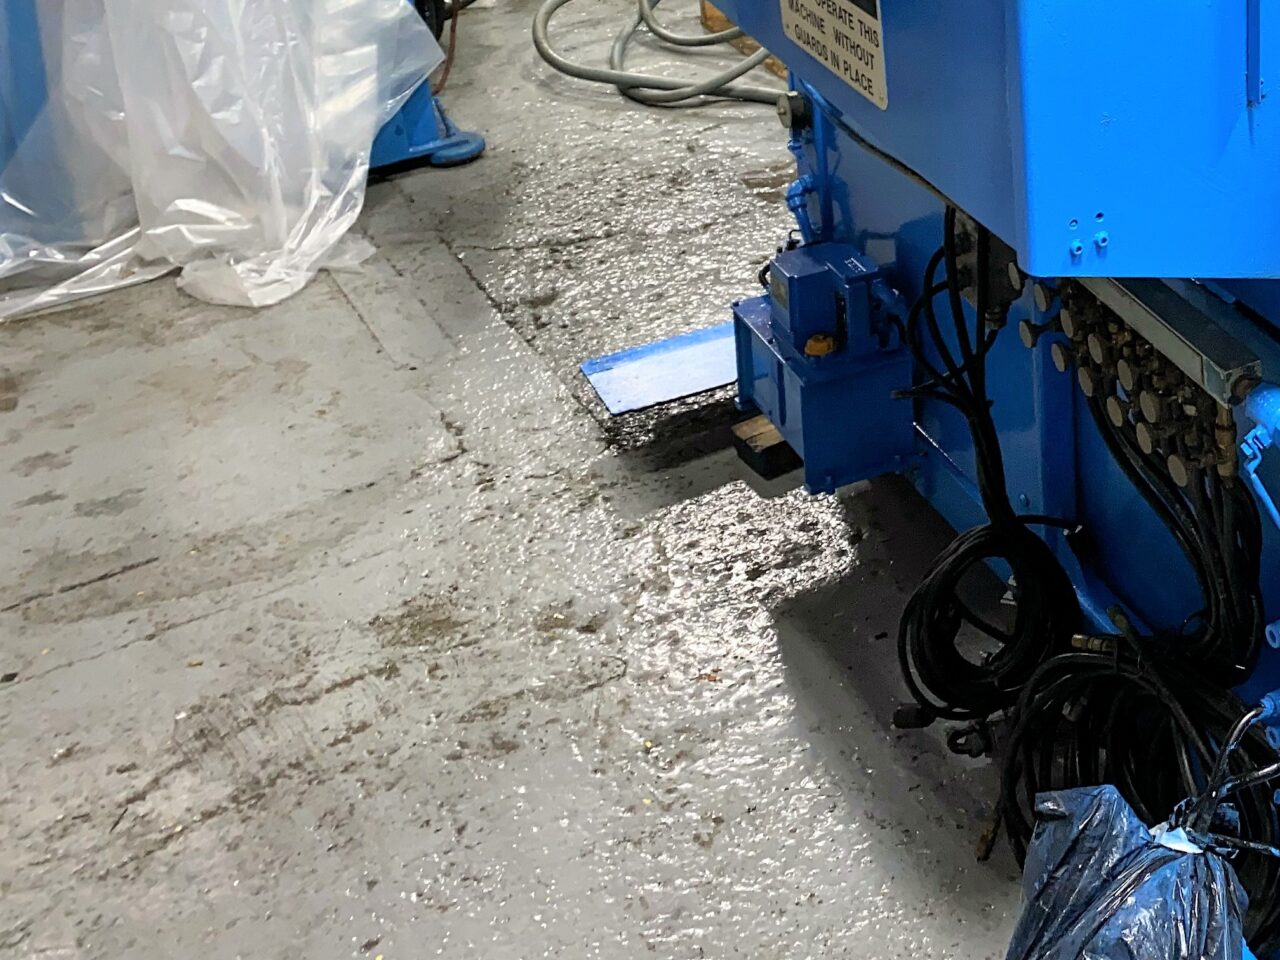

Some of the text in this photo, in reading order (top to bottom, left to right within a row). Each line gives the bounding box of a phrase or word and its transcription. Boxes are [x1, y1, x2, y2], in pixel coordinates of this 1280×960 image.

[833, 26, 874, 70] WITHOUT
[858, 19, 879, 48] THIS
[794, 24, 874, 96] GUARDS IN PLACE
